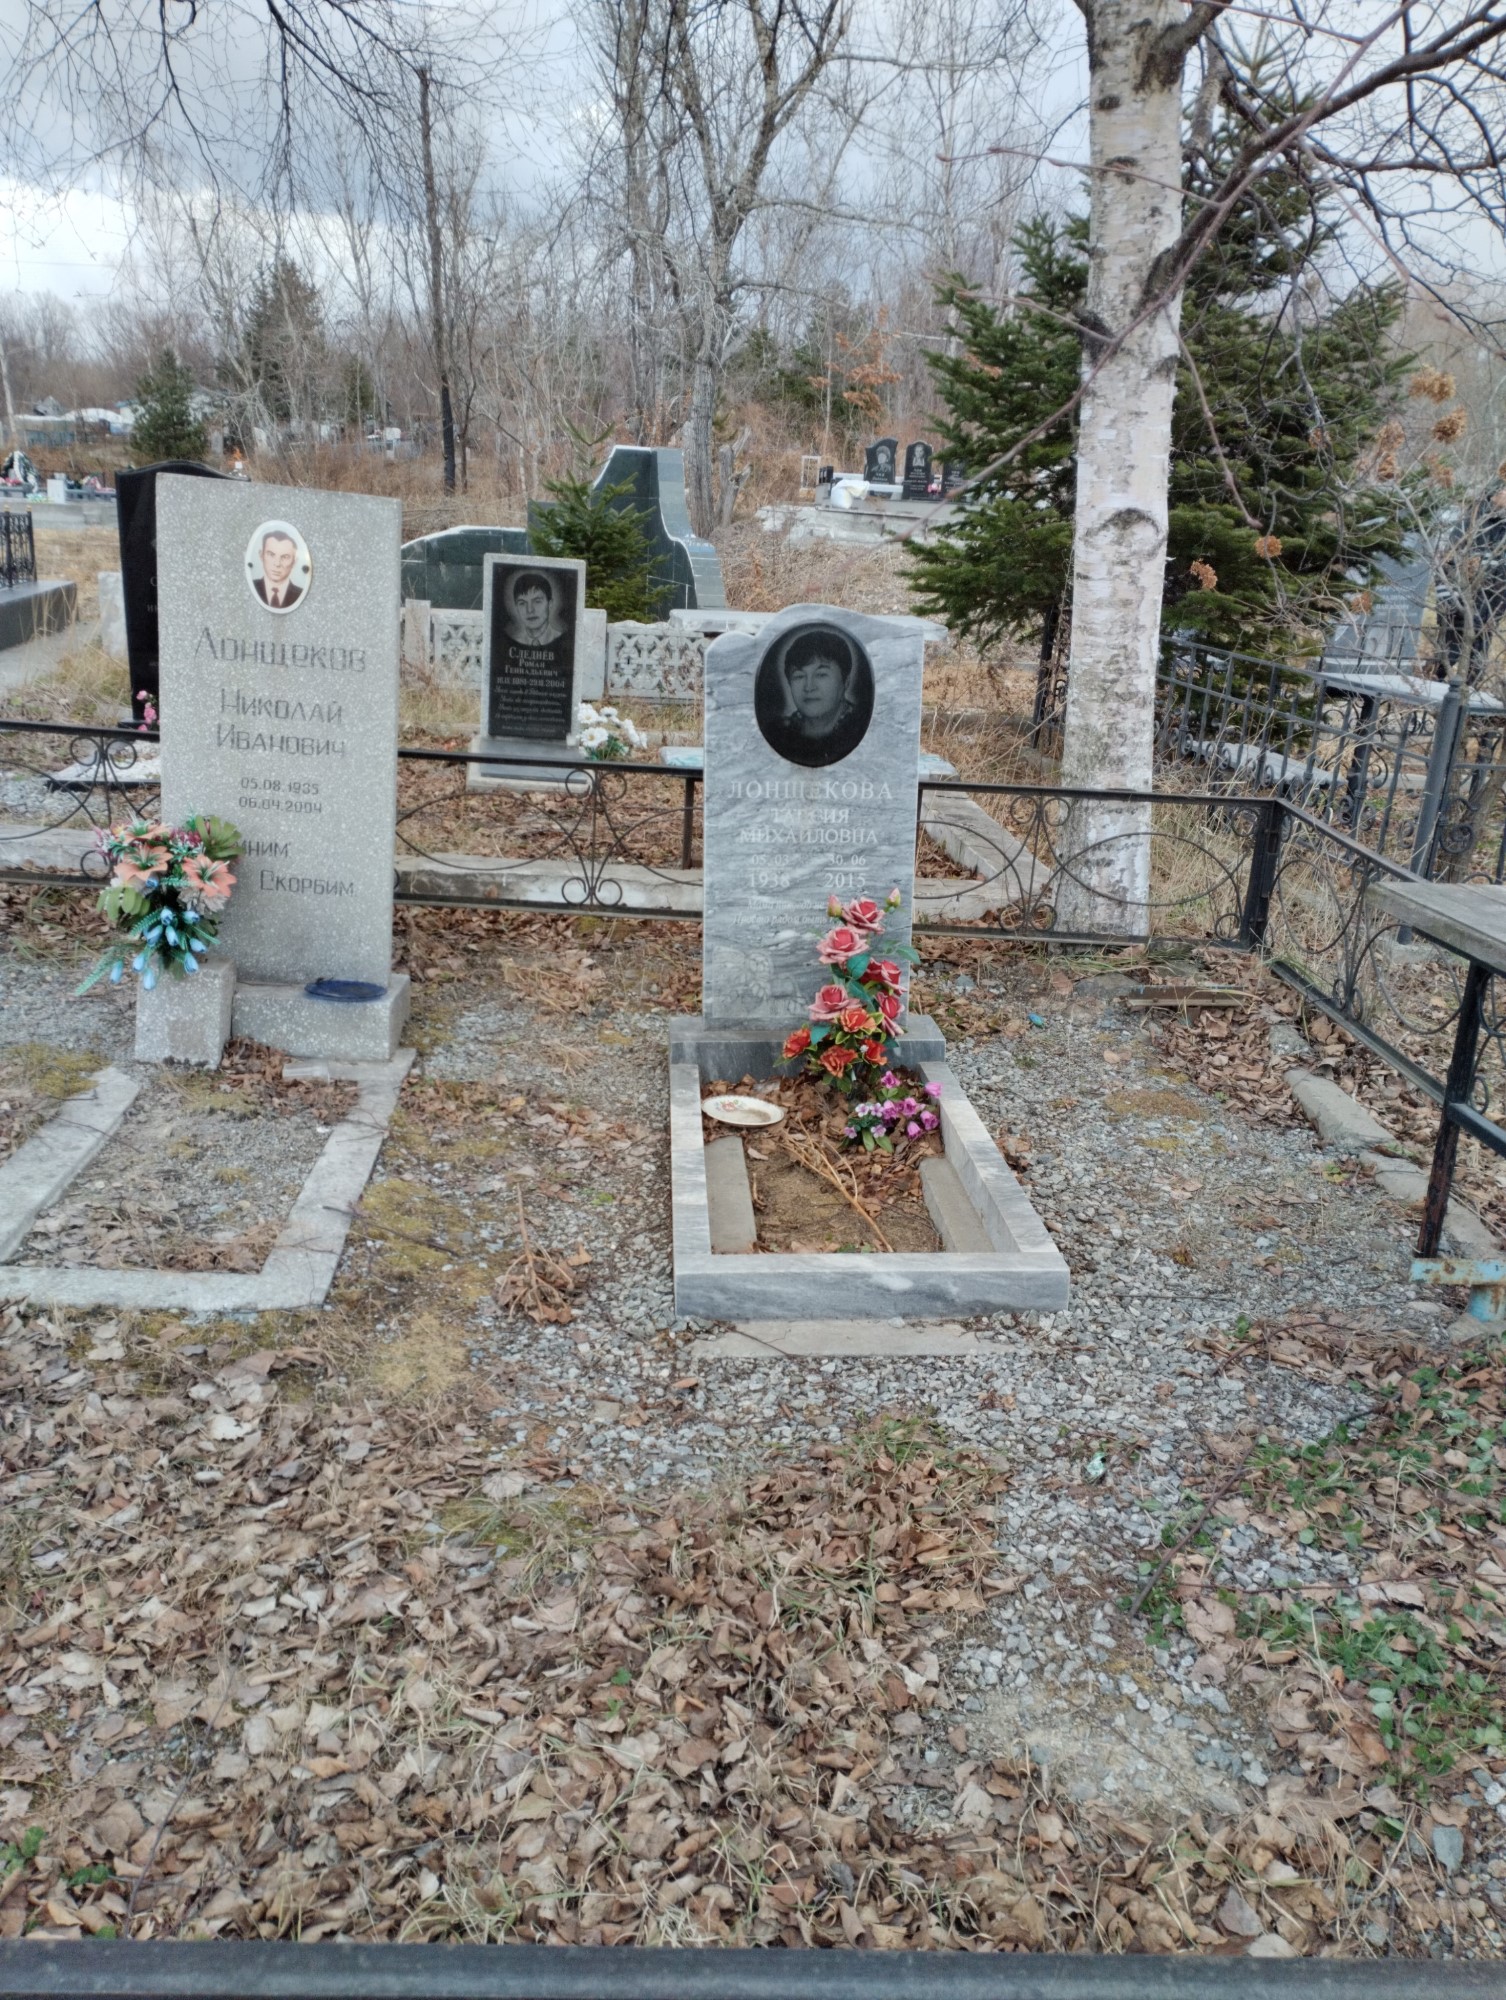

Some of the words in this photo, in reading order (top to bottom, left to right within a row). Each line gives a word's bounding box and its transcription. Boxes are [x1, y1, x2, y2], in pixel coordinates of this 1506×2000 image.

[241, 777, 319, 795] 05.08.1935
[239, 796, 322, 814] 06.04.2004
[824, 872, 866, 888] 2015
